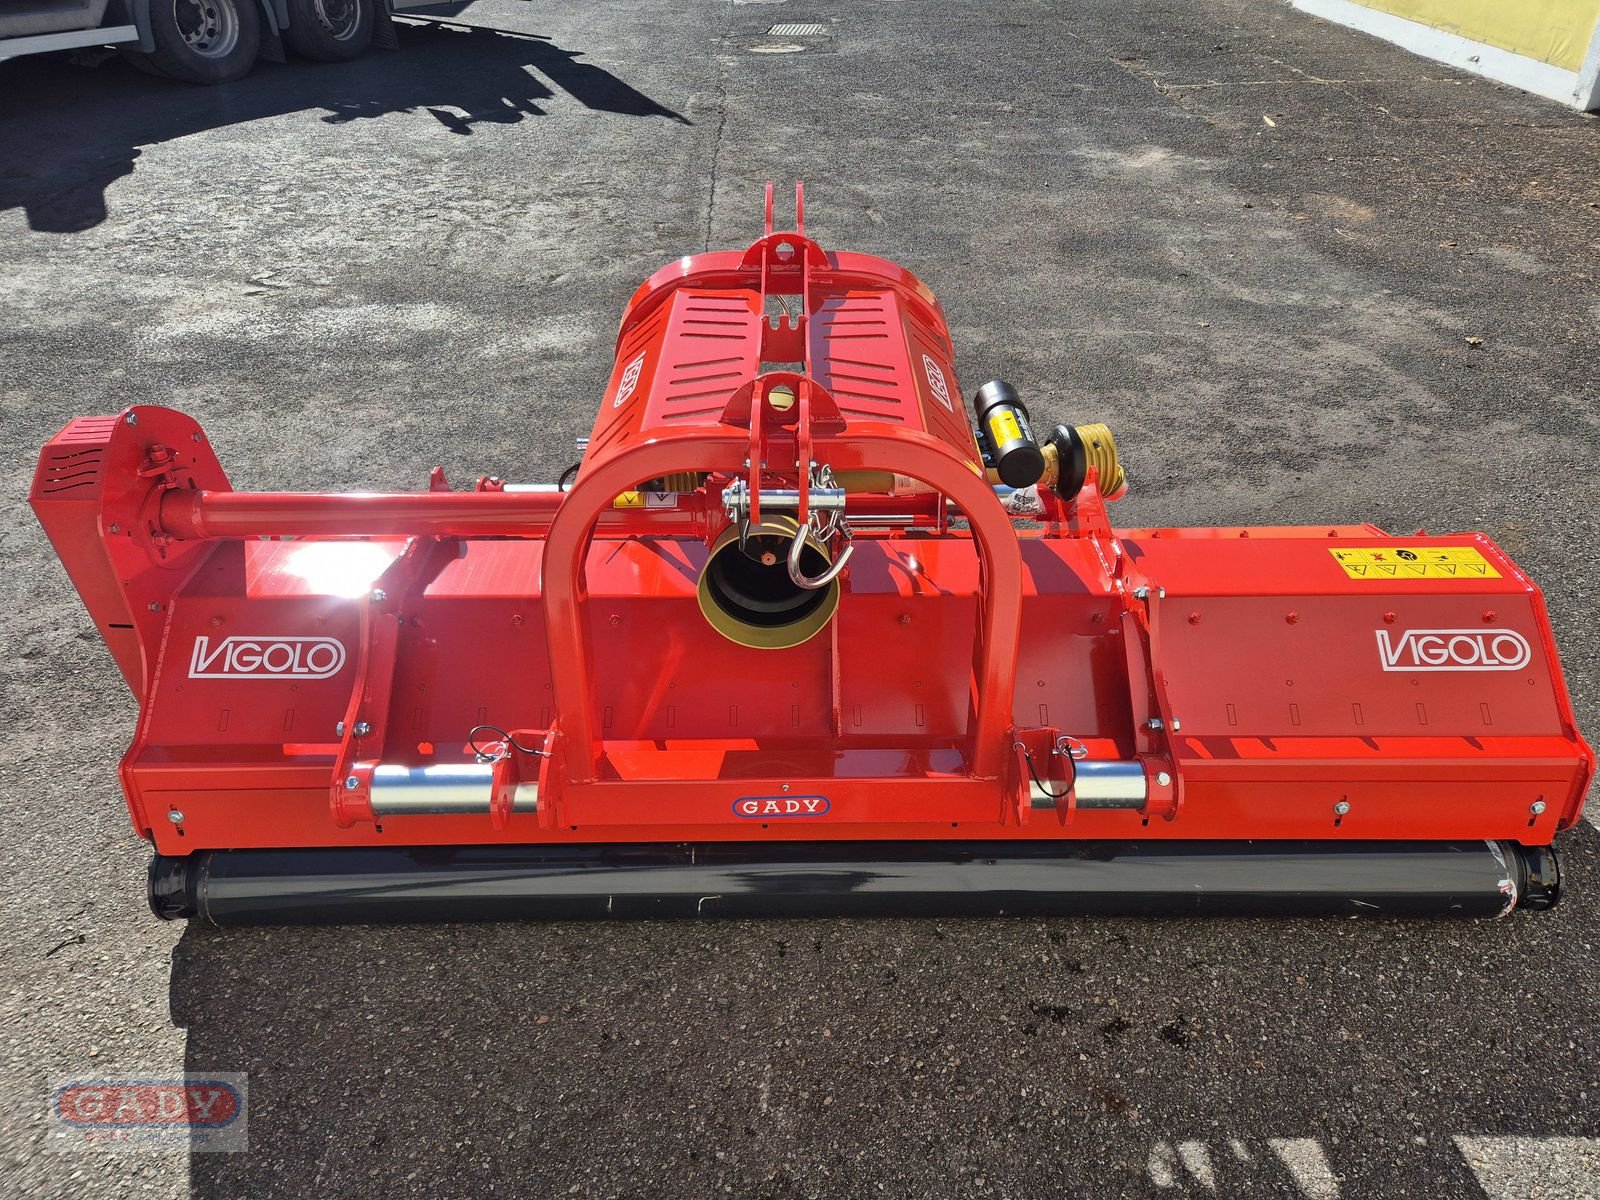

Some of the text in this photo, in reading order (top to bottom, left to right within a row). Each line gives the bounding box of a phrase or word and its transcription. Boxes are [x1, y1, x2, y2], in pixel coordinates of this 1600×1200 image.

[188, 635, 347, 680] VIGOLO
[1375, 628, 1532, 672] VIGOLO
[742, 799, 820, 814] GADY
